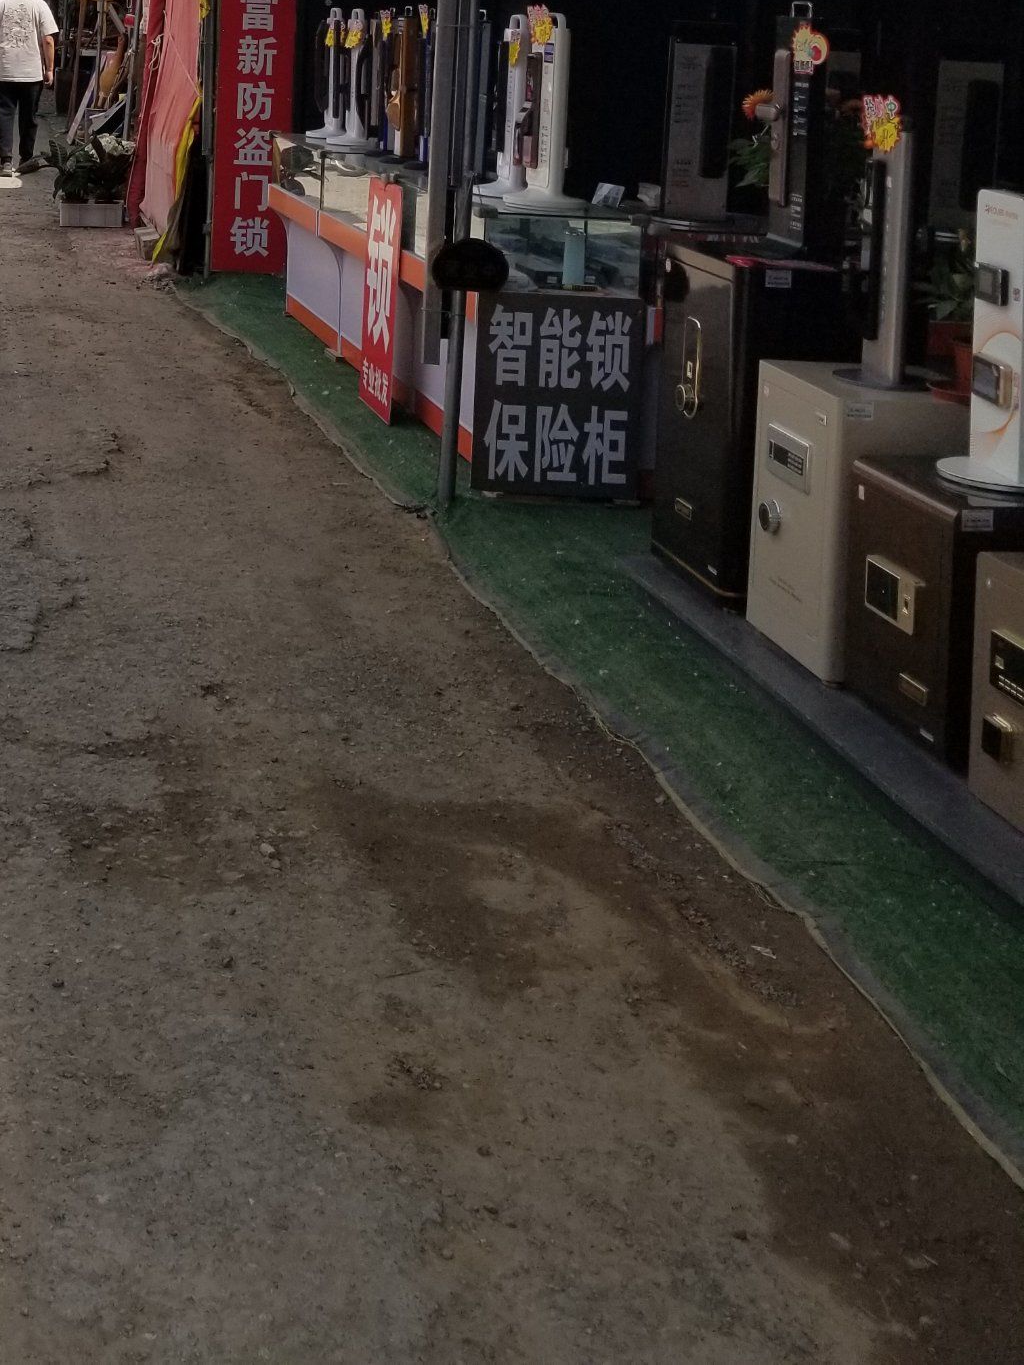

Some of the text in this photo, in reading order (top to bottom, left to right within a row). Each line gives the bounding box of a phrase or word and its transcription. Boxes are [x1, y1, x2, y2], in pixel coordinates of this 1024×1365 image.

[367, 194, 397, 354] 锁
[362, 357, 389, 406] 专业批发
[488, 304, 633, 392] 智能锁
[483, 399, 629, 485] 保险柜
